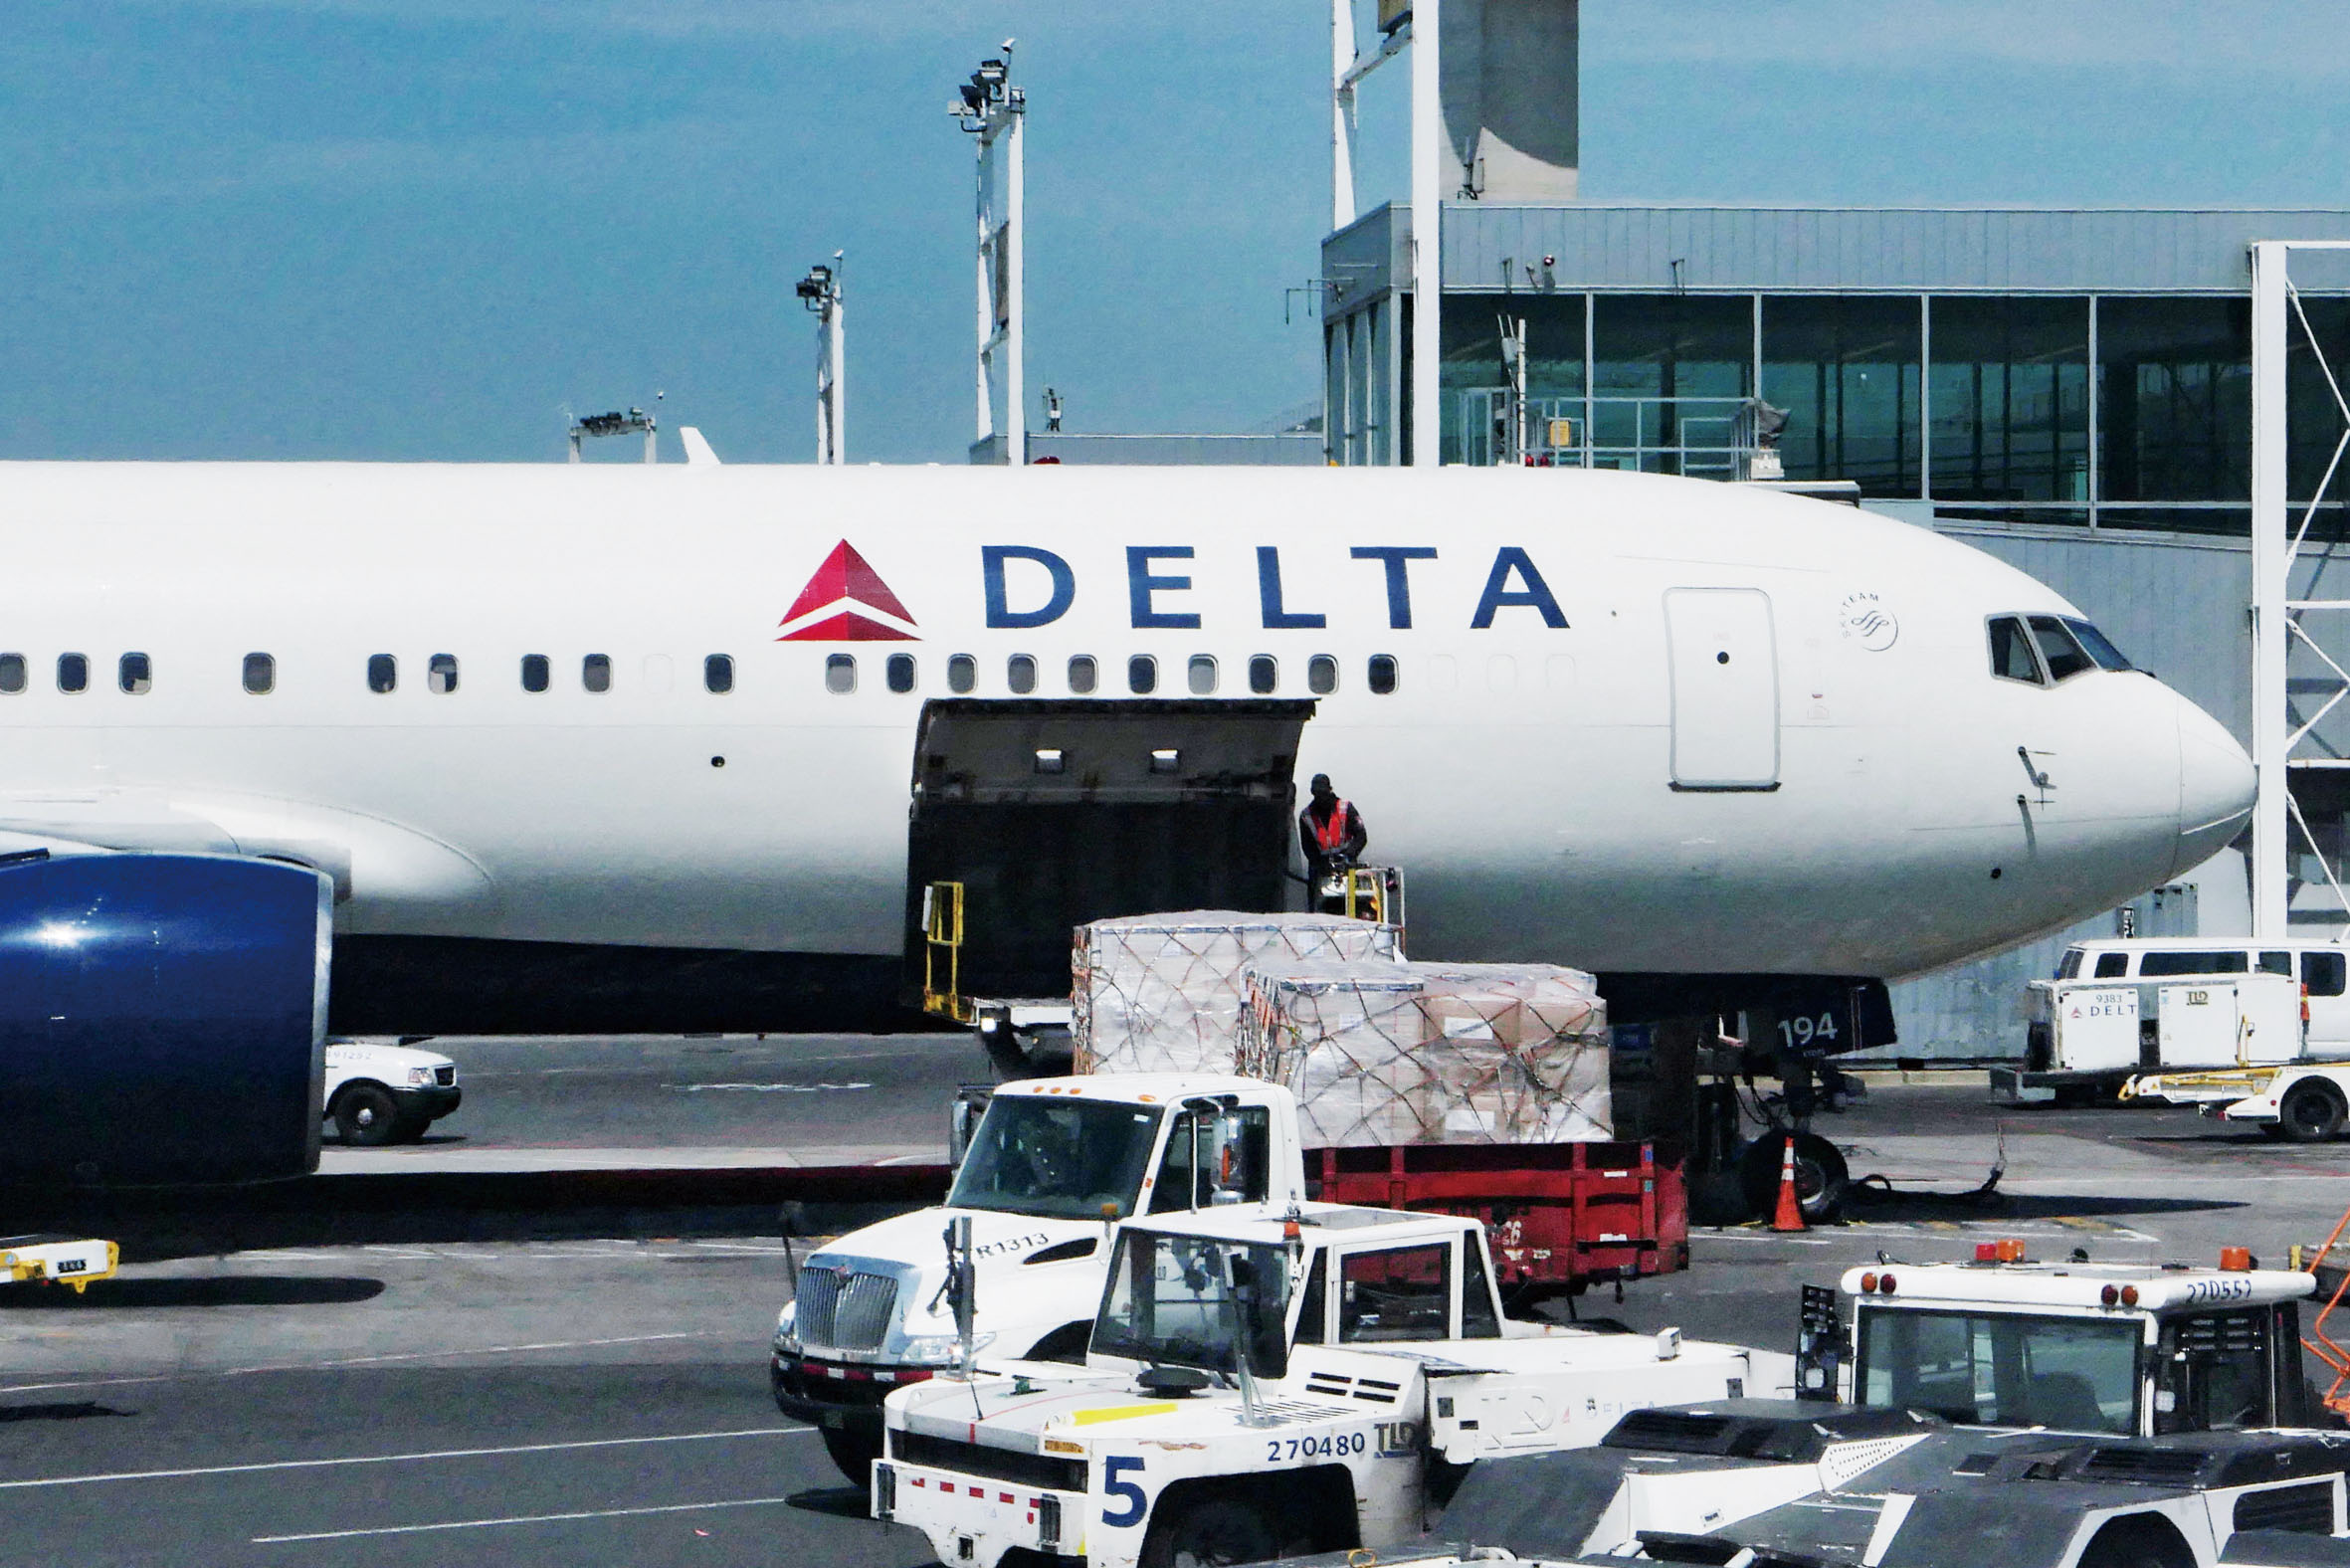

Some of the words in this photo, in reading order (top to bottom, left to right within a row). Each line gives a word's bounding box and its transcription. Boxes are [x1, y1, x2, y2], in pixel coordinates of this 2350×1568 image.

[981, 545, 1571, 629] DELTA
[1778, 1012, 1838, 1048] 194
[975, 1233, 1049, 1259] R1313
[1268, 1433, 1365, 1462] 270480
[1101, 1456, 1147, 1528] 5
